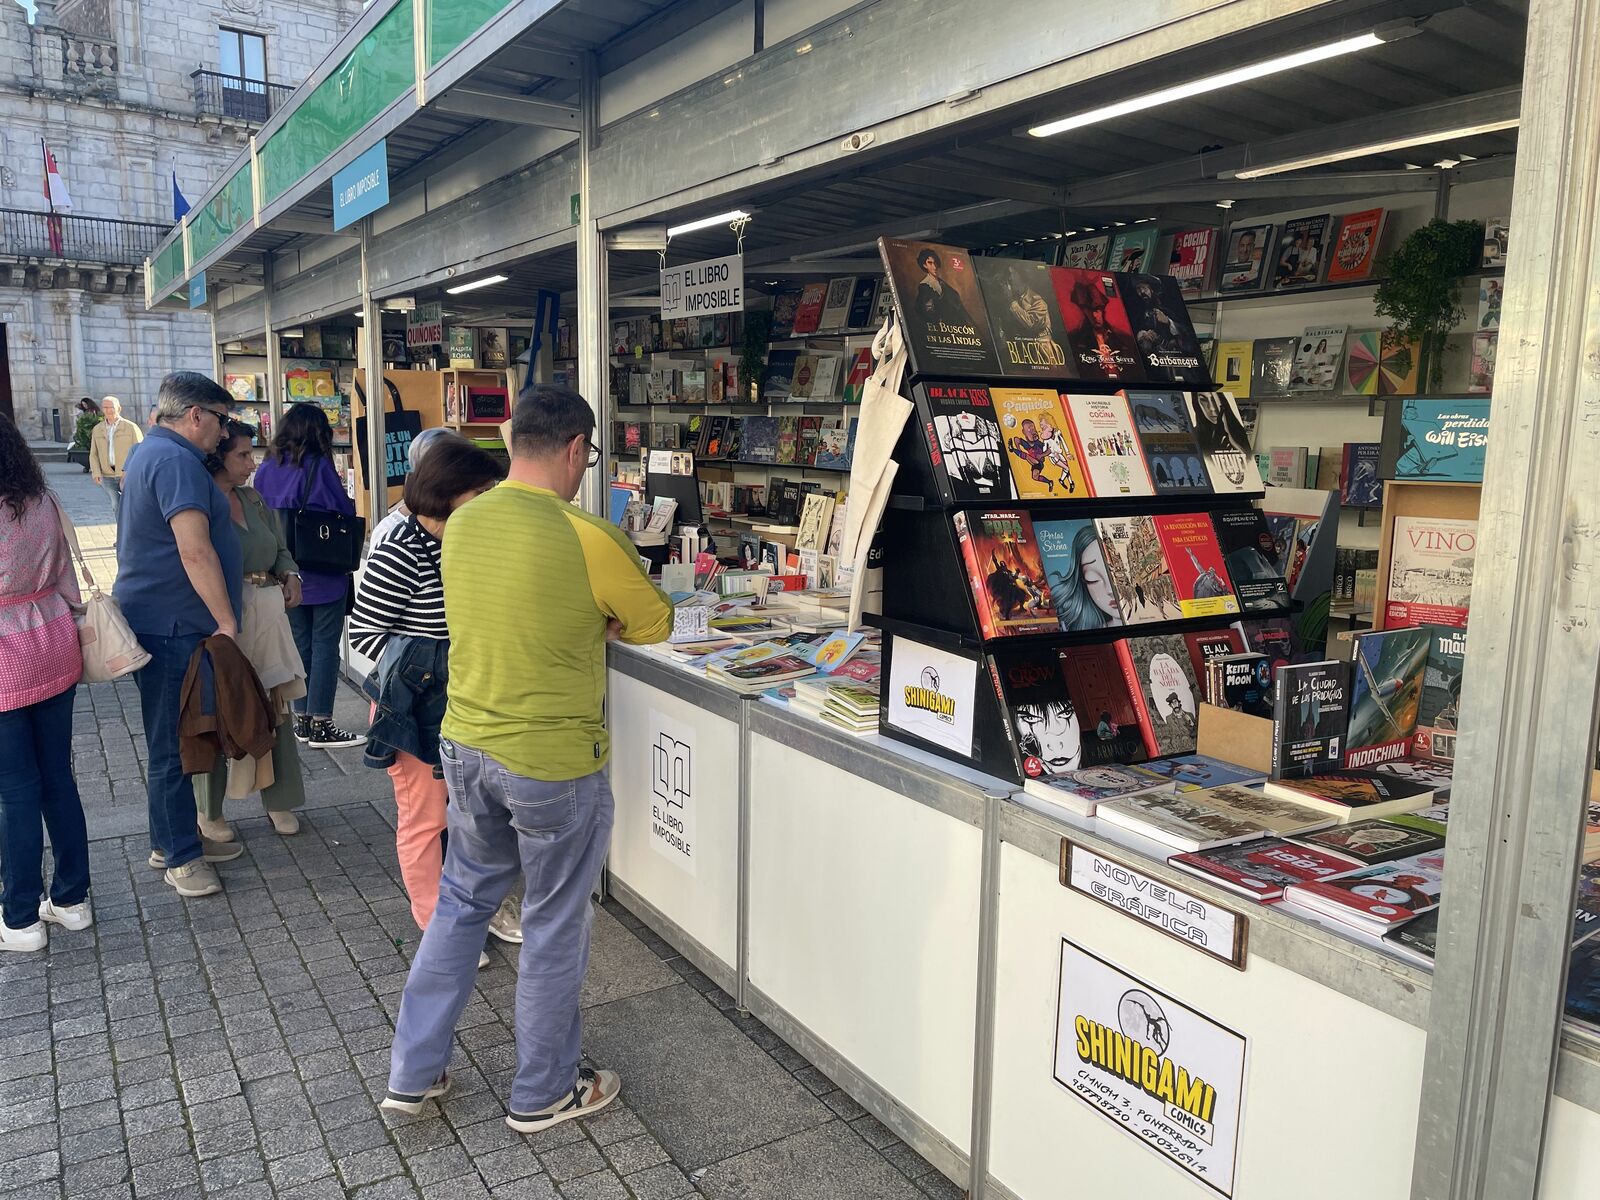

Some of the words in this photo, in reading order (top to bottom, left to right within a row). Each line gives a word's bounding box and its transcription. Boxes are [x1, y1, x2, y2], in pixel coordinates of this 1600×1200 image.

[357, 169, 380, 198] IMPOSIBLE
[1183, 229, 1210, 248] COCINA
[684, 270, 697, 288] EL
[699, 263, 729, 285] LIBRO
[685, 288, 740, 312] IMPOSIBLE
[407, 324, 441, 344] QUIÑONES
[940, 322, 975, 336] BUSCÓN
[939, 336, 952, 345] LAS
[951, 333, 982, 347] INDIAS
[1005, 340, 1066, 366] BLACKSAD
[1147, 353, 1199, 368] Barbanegra
[930, 387, 968, 399] BLACK
[1002, 399, 1054, 414] Paquetes
[1442, 418, 1489, 430] perdida
[398, 430, 412, 442] UN
[1425, 430, 1455, 446] Will
[784, 491, 798, 500] KING
[1170, 521, 1197, 530] REVOLUCIÓN
[1039, 530, 1063, 541] Perlas
[1407, 530, 1475, 551] VINO
[1042, 541, 1068, 552] Sirena
[1203, 645, 1214, 655] EL
[1214, 642, 1230, 653] ALA
[1153, 667, 1180, 676] BALADA
[1226, 663, 1250, 675] KEITH
[1226, 674, 1252, 686] MOON
[1297, 679, 1308, 692] LA
[1310, 677, 1337, 691] CIUDAD
[904, 685, 956, 717] SHINIGAMI
[1301, 693, 1310, 703] LOS
[1312, 687, 1343, 703] PRODIGIOS
[1349, 742, 1405, 768] INDOCHINA
[653, 805, 662, 821] EL
[662, 811, 684, 834] LIBRO
[652, 822, 691, 857] IMPOSIBLE
[1263, 849, 1337, 875] 1984
[1093, 858, 1207, 921] NOVELA
[1090, 880, 1208, 947] GRÁFICA
[1074, 1014, 1218, 1124] SHINIGAMI
[1072, 1078, 1130, 1122] 987798730
[1141, 1128, 1208, 1173] 670326914
[1170, 1107, 1207, 1136] COMICS
[1136, 1108, 1204, 1156] PONFERRADA
